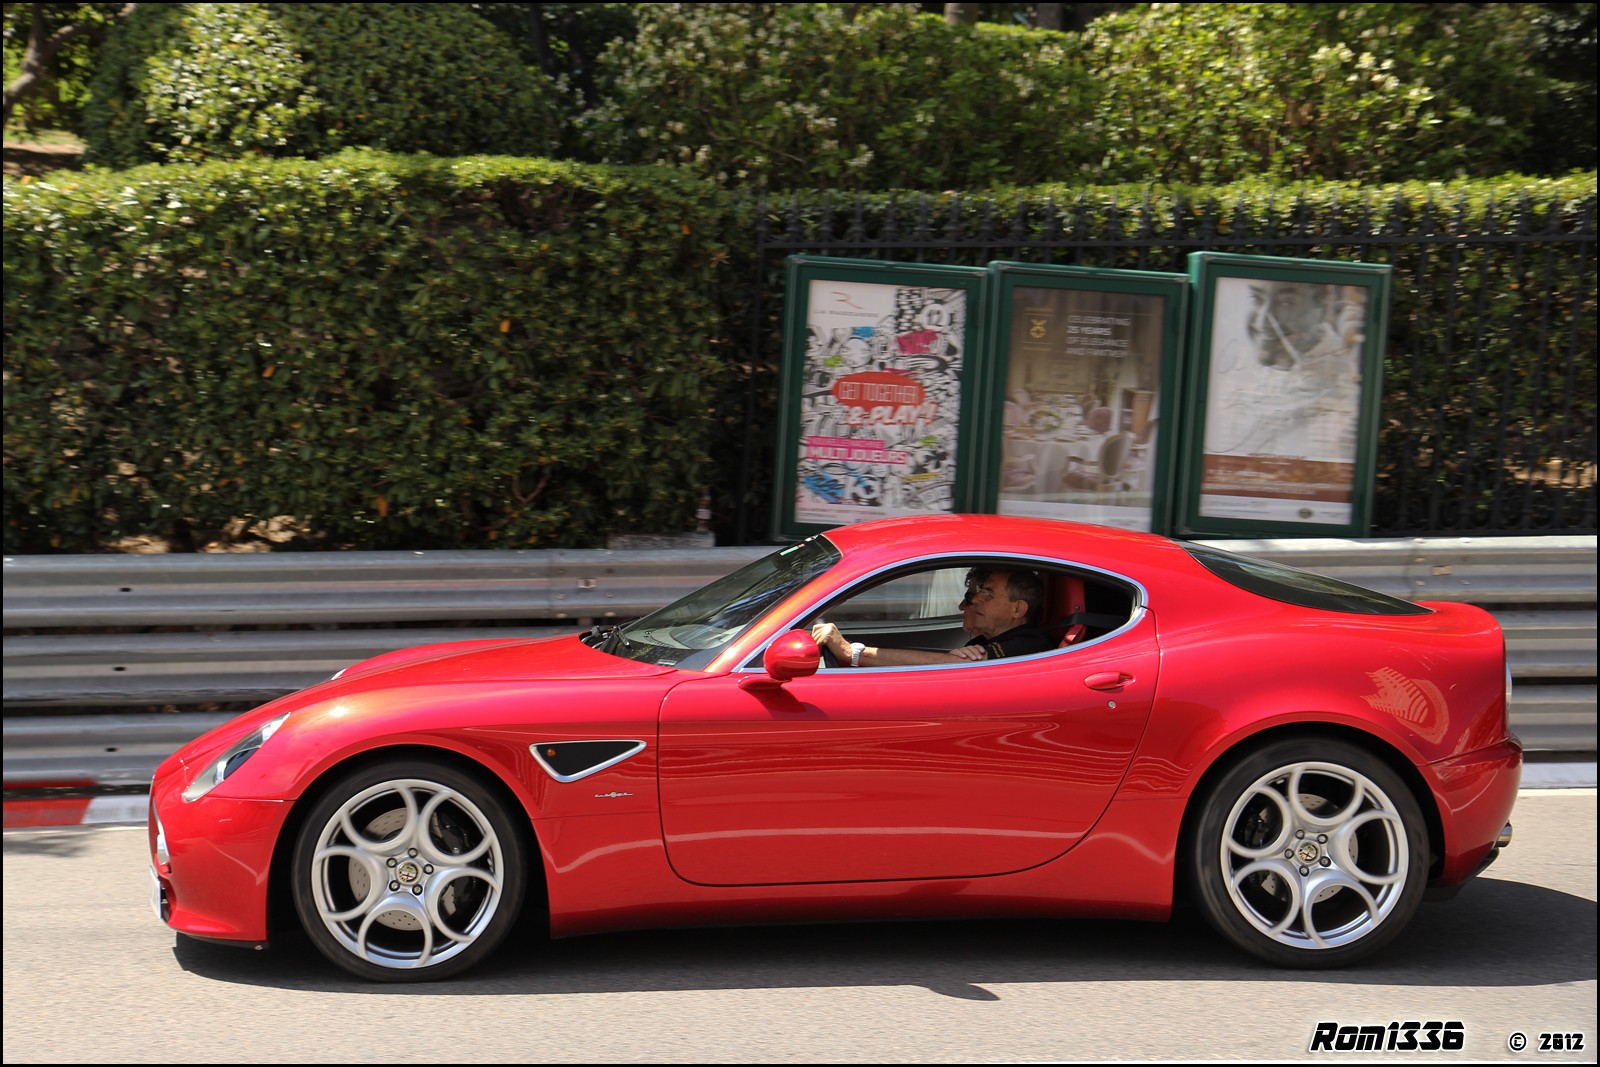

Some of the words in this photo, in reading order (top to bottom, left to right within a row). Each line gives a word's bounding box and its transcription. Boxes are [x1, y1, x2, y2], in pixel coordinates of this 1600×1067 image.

[1068, 314, 1131, 326] CELEBRATING
[1081, 327, 1112, 336] YEARS
[838, 381, 861, 400] GET
[862, 382, 919, 404] TOGETHER
[848, 404, 864, 426] &
[808, 446, 848, 460] MULTI
[848, 448, 908, 463] JOUEURS
